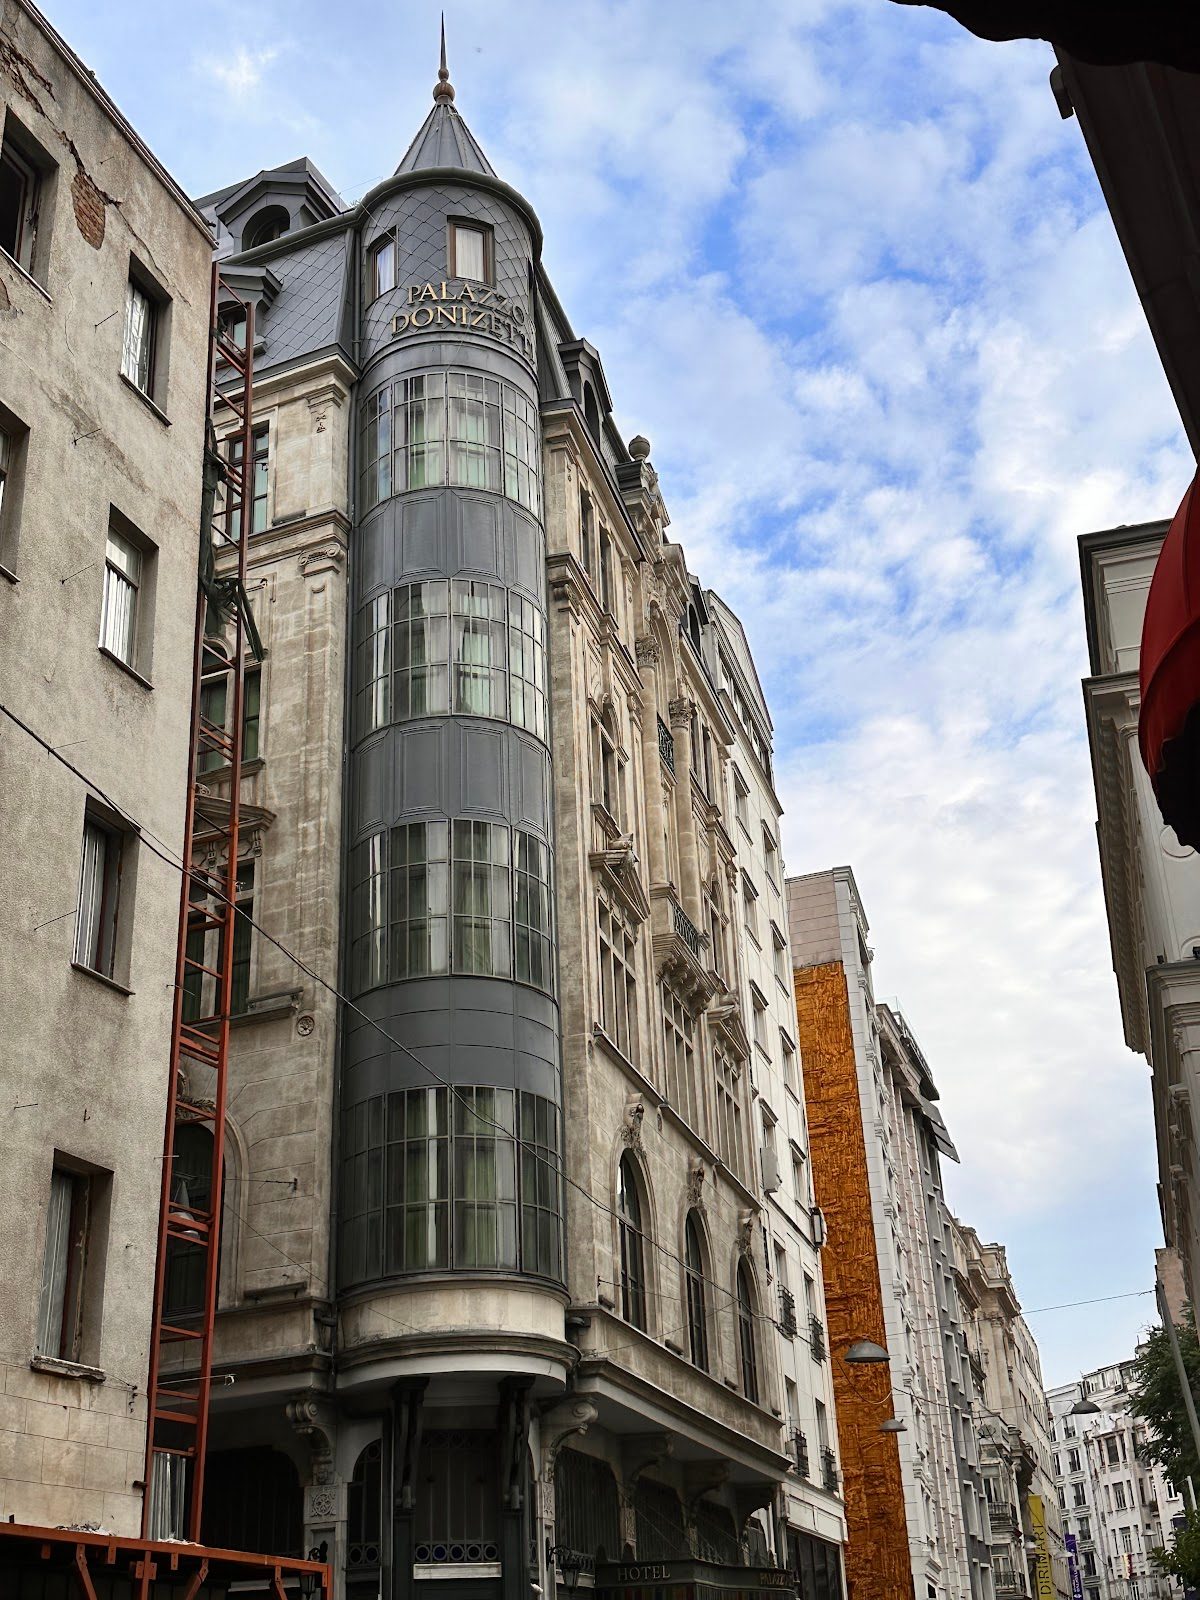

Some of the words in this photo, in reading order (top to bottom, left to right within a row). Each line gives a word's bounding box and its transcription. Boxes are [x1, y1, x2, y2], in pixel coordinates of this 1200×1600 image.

[406, 281, 525, 326] PALAZZO
[617, 1565, 671, 1582] HOTEL
[1032, 1523, 1052, 1596] DIRIMART
